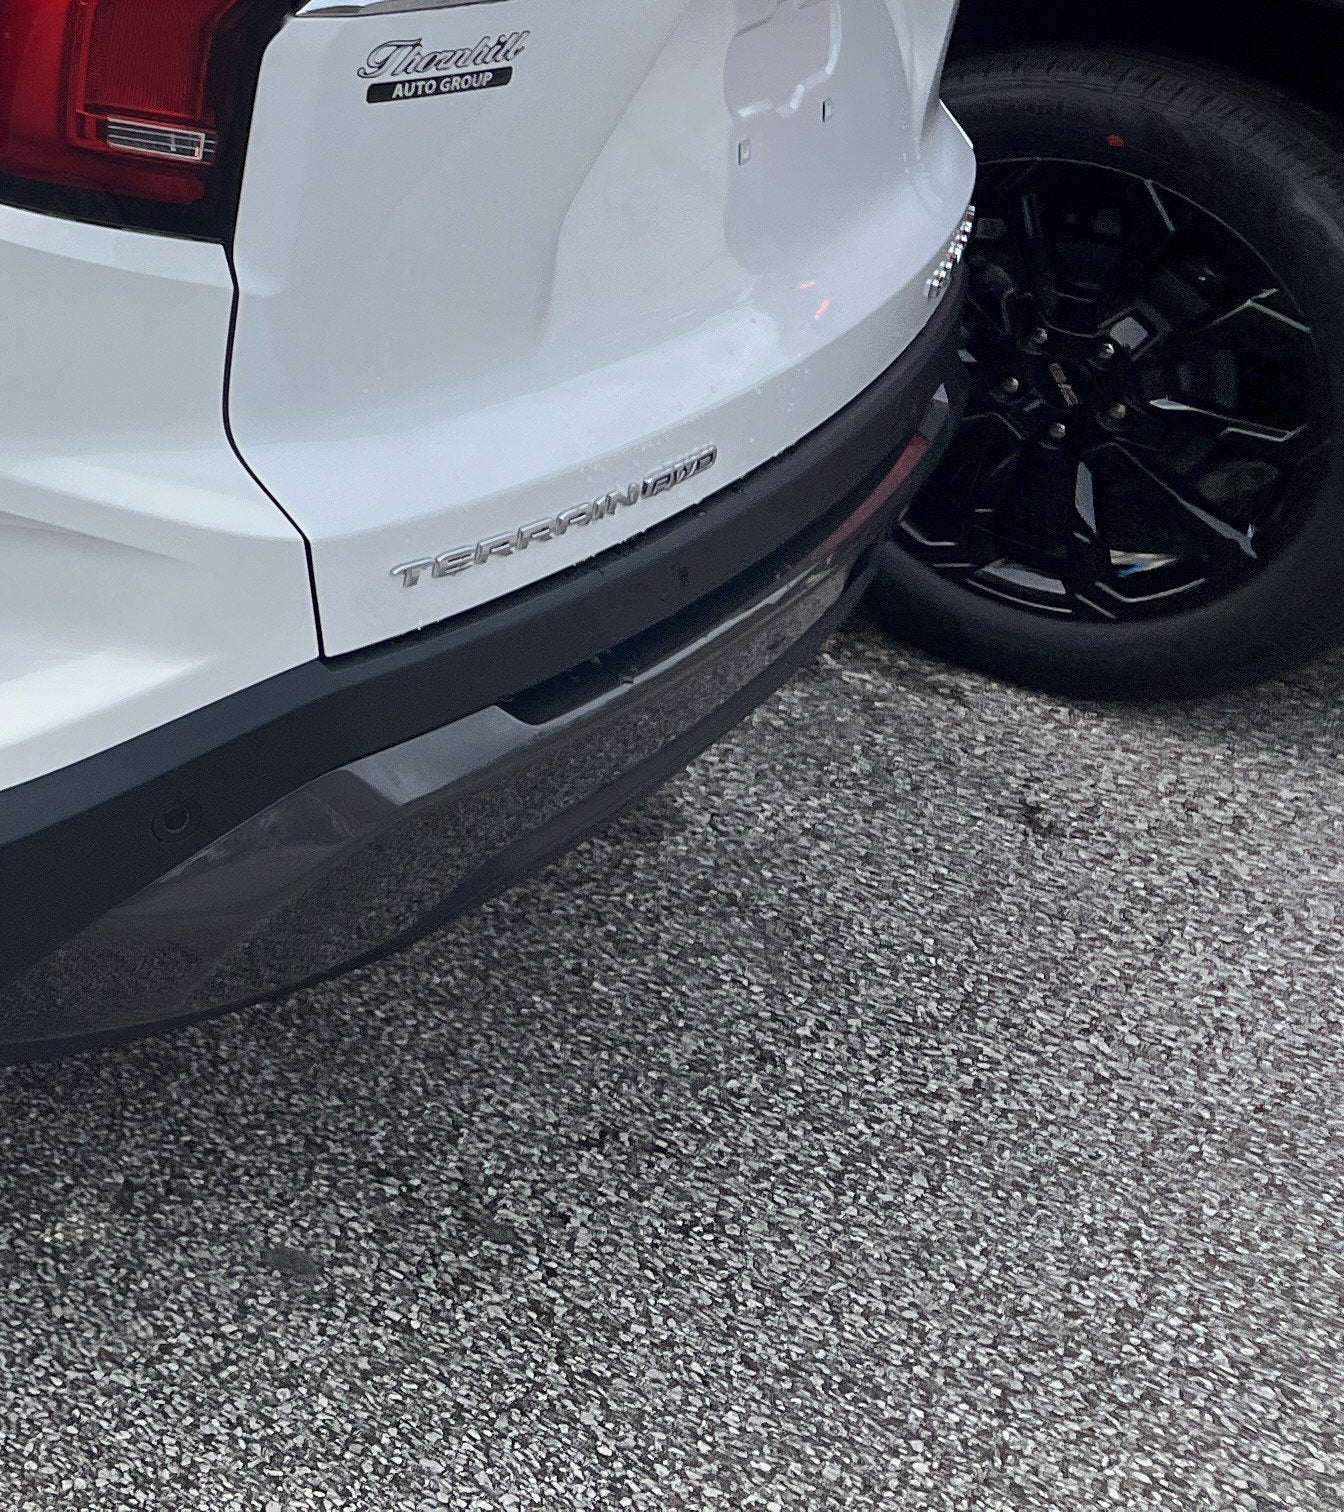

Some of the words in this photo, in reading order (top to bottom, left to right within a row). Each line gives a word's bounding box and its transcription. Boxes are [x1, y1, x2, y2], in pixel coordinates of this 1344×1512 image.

[357, 30, 530, 78] Thornhill
[392, 79, 437, 99] AUTO
[439, 71, 493, 93] GROUP
[390, 482, 639, 588] TERRAIN
[642, 442, 717, 499] AWD
